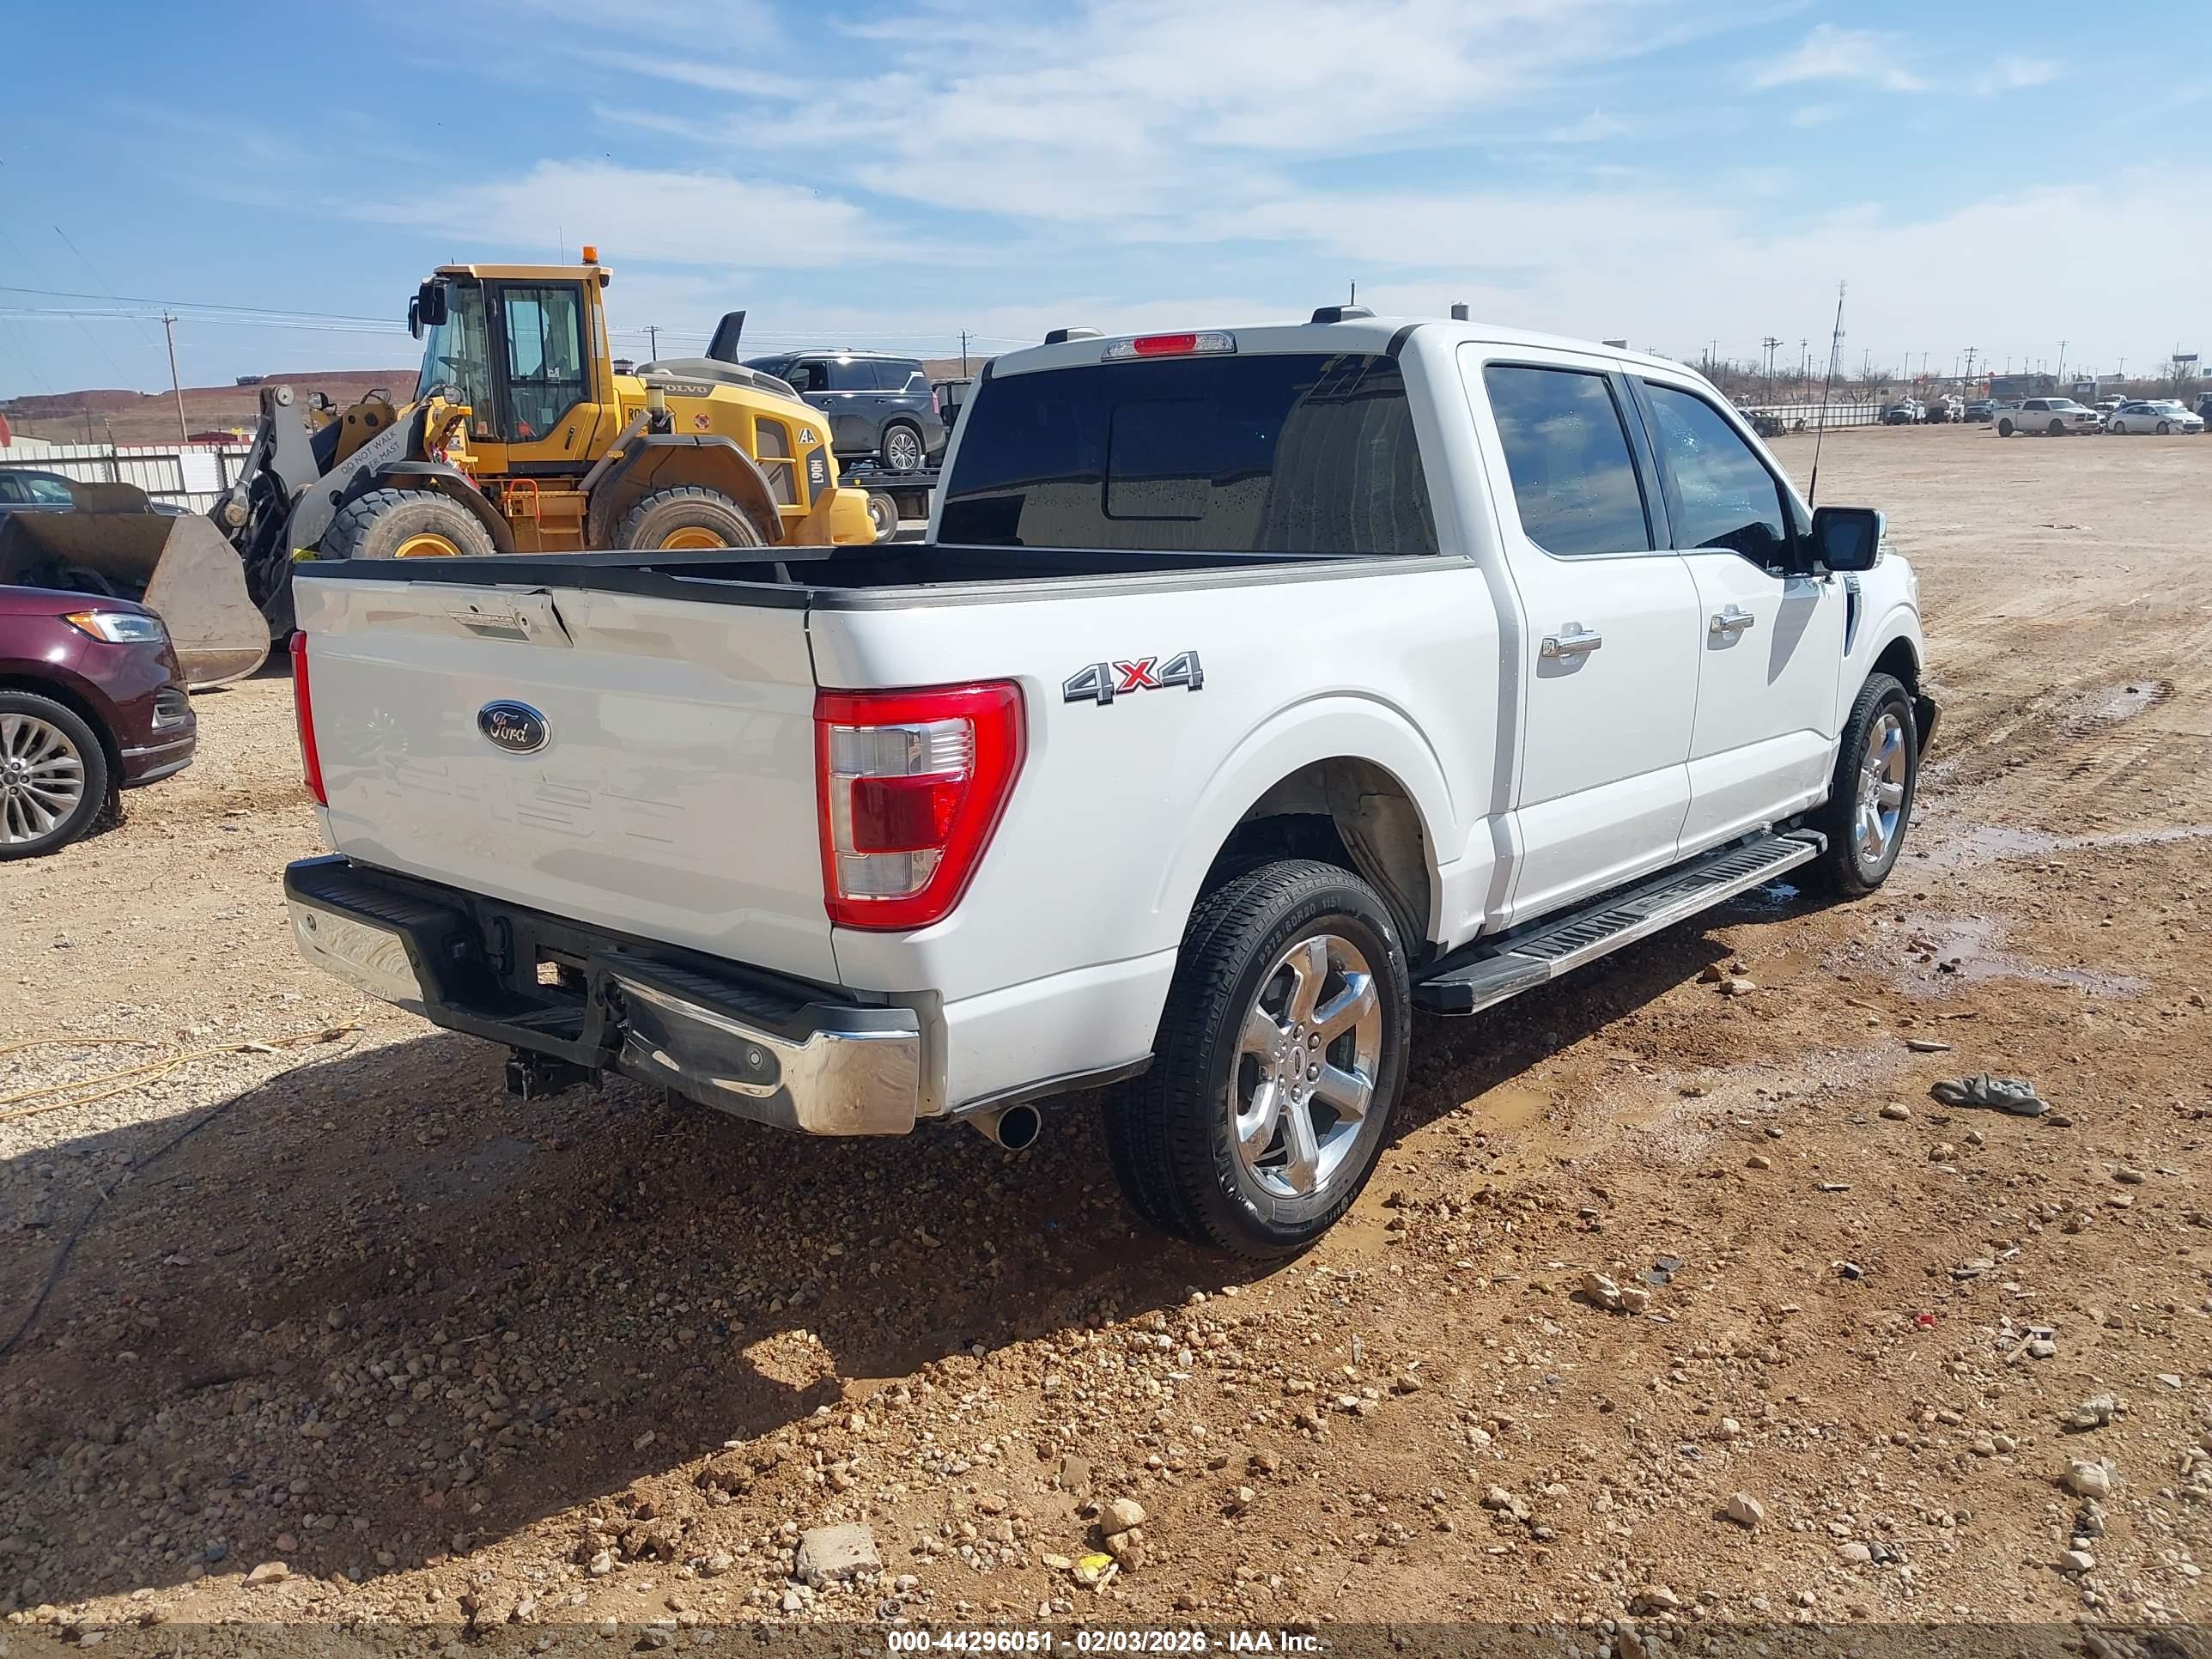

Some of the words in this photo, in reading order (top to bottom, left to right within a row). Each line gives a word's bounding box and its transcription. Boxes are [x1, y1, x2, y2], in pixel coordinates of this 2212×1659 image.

[652, 383, 708, 393] OLVO
[340, 462, 355, 475] DO
[354, 447, 373, 465] NOT
[373, 429, 398, 450] WALK
[380, 441, 401, 461] MAST
[810, 459, 825, 483] L90H
[489, 710, 530, 744] Ford
